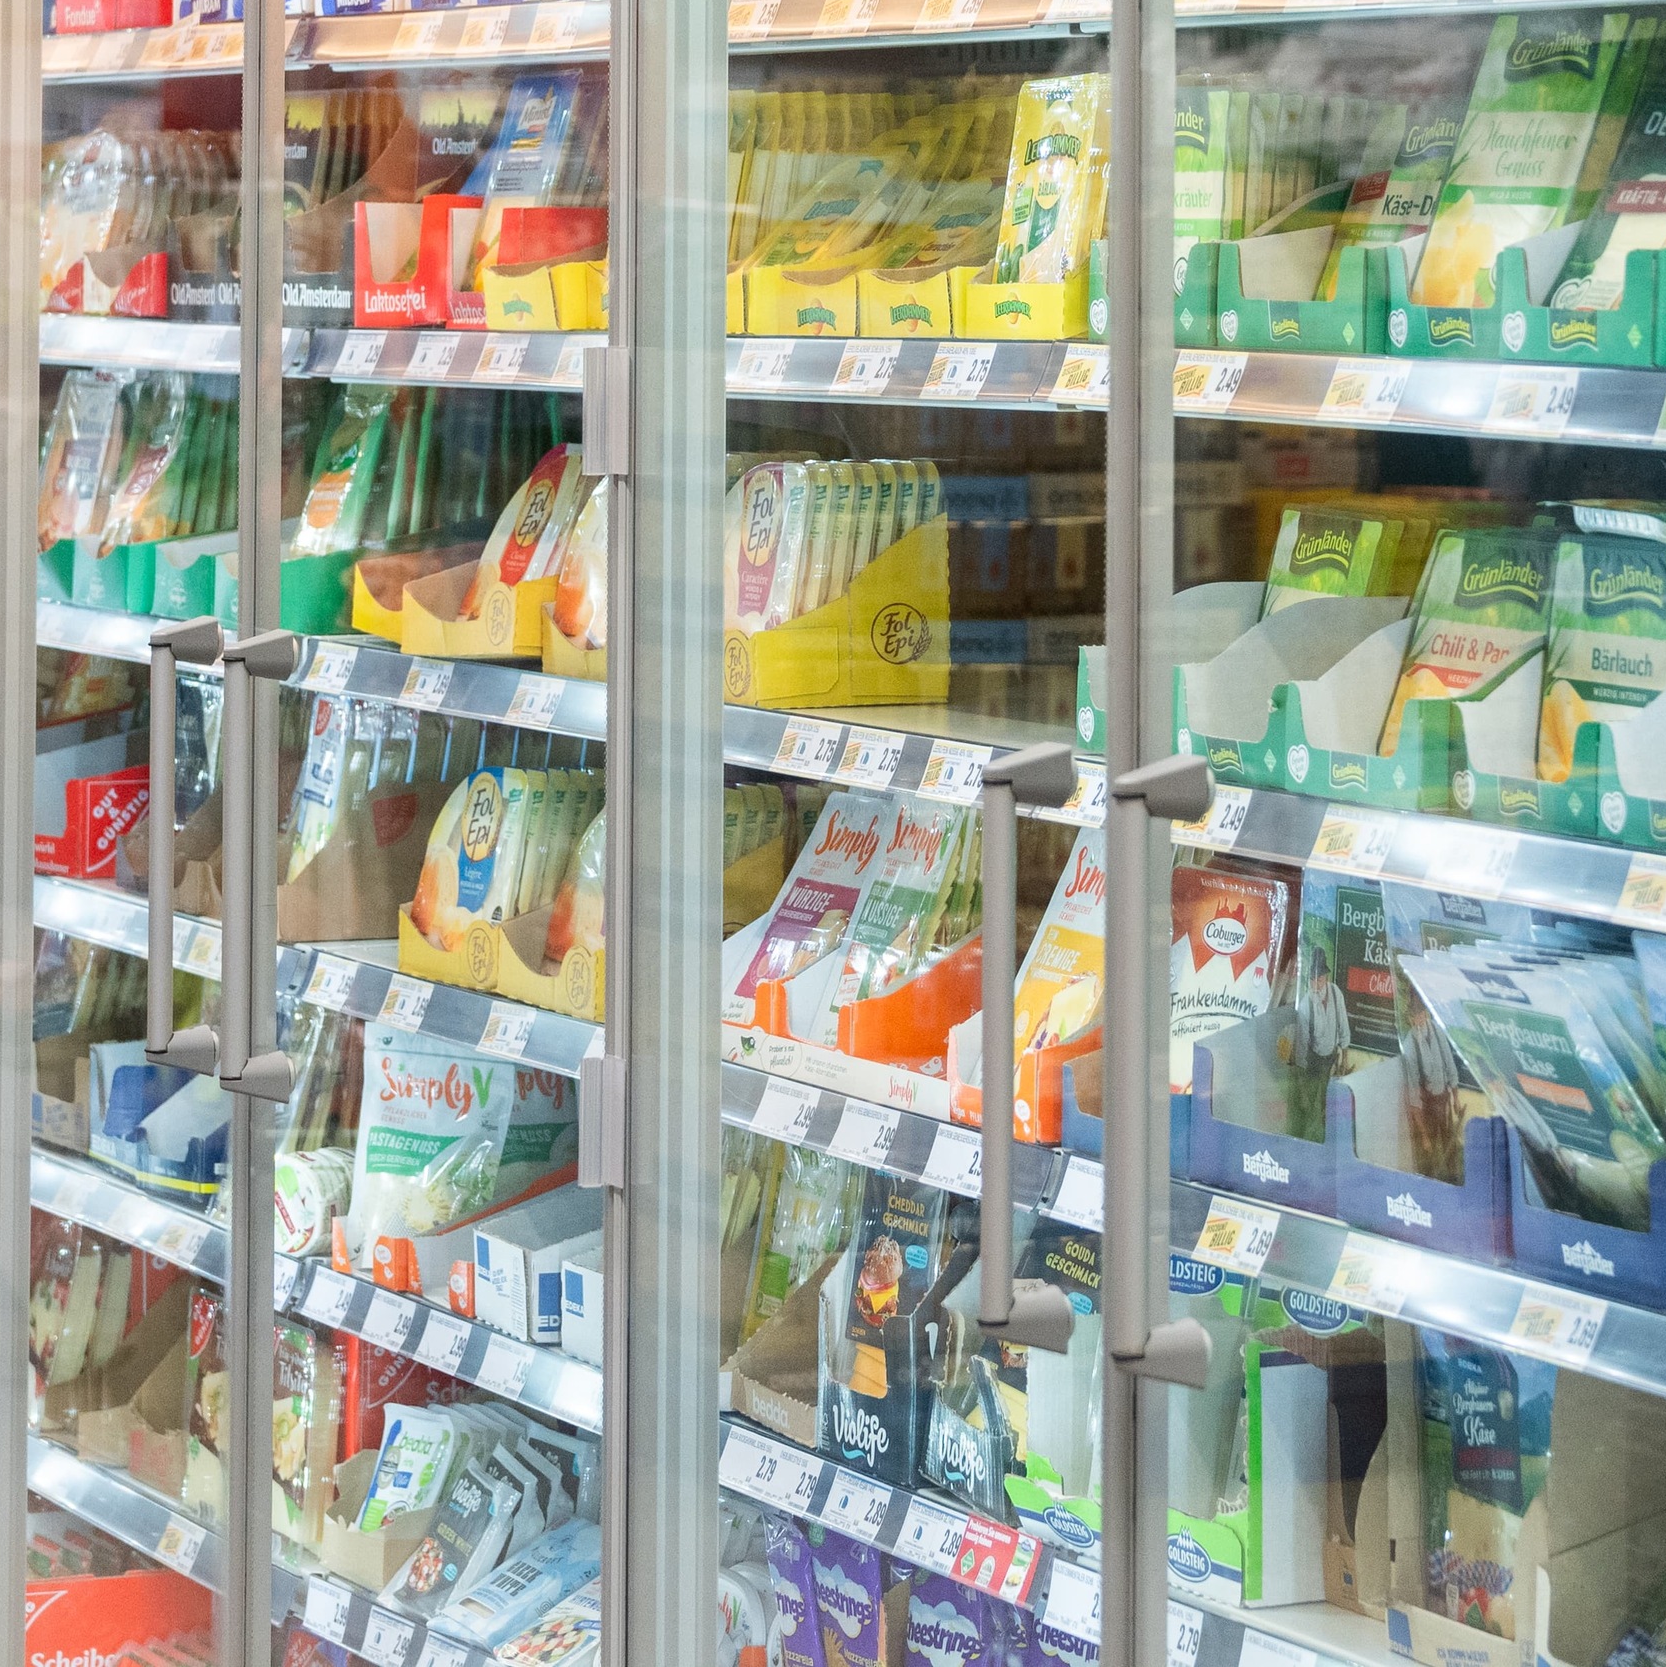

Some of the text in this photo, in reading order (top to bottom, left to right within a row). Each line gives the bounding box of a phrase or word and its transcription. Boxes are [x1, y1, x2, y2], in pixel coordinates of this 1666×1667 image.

[1513, 28, 1592, 65] Grünländer
[1481, 120, 1579, 159] Hauchfeiner
[1494, 156, 1545, 179] Genuss
[300, 283, 352, 309] Amsterdam
[364, 288, 426, 321] Laktosefrei
[995, 300, 1031, 320] LEERDAMMER
[797, 306, 836, 331] LEERDAMMER
[890, 304, 933, 327] LEERDAMMER
[1429, 318, 1471, 339] Grünländer
[1552, 318, 1597, 338] Grünländer
[967, 358, 989, 383] 2.75
[1216, 369, 1242, 393] 2.49
[1177, 375, 1205, 397] BILLIG
[1546, 386, 1575, 414] 2.49
[752, 488, 774, 521] Fol
[747, 519, 773, 567] Epi
[1296, 530, 1352, 559] Grünländer
[1464, 559, 1543, 593] Grünländer
[1590, 564, 1664, 597] Grünländer
[880, 611, 911, 636] Fol
[884, 630, 916, 658] Epi
[1431, 633, 1478, 660] Chili &
[1591, 647, 1653, 677] Bärlauch
[814, 739, 838, 763] 2.75
[878, 747, 900, 773] 2.75
[471, 783, 496, 818] Fol
[1219, 804, 1246, 831] 2.49
[466, 818, 492, 862] Epi
[815, 809, 881, 875] Simply
[786, 884, 834, 913] WÜRZIGE
[1206, 922, 1245, 946] Coburger
[1036, 944, 1081, 972] CREMIGE
[1475, 1013, 1572, 1056] Bergbauern
[1514, 1050, 1557, 1078] Käse
[380, 1057, 473, 1122] Simply
[888, 1075, 913, 1109] Simply
[794, 1105, 816, 1128] 2.99
[874, 1125, 895, 1151] 2.99
[1243, 1151, 1290, 1183] Bergader
[888, 1194, 925, 1218] CHEDDAR
[1386, 1194, 1432, 1228] Bergader
[883, 1211, 929, 1237] GESCHMACK
[1065, 1240, 1096, 1266] GOUDA
[1208, 1230, 1235, 1248] BILLIG
[1246, 1227, 1273, 1257] 2.69
[1045, 1252, 1101, 1289] GESCHMACK
[1561, 1242, 1615, 1276] Bergader
[1289, 1291, 1342, 1321] GOLDSTEIG
[1567, 1317, 1598, 1349] 2.69
[833, 1405, 890, 1468] Violife
[1463, 1415, 1496, 1446] Käse
[755, 1455, 778, 1482] 2.79
[939, 1422, 984, 1492] Violife
[452, 1478, 482, 1514] Violife
[795, 1471, 818, 1498] 2.79
[864, 1498, 887, 1526] 2.89
[1049, 1516, 1088, 1538] GOLDSTEIG
[939, 1530, 962, 1558] 2.89
[1168, 1545, 1205, 1572] GOLDSTEIG
[1176, 1624, 1200, 1656] 2.79
